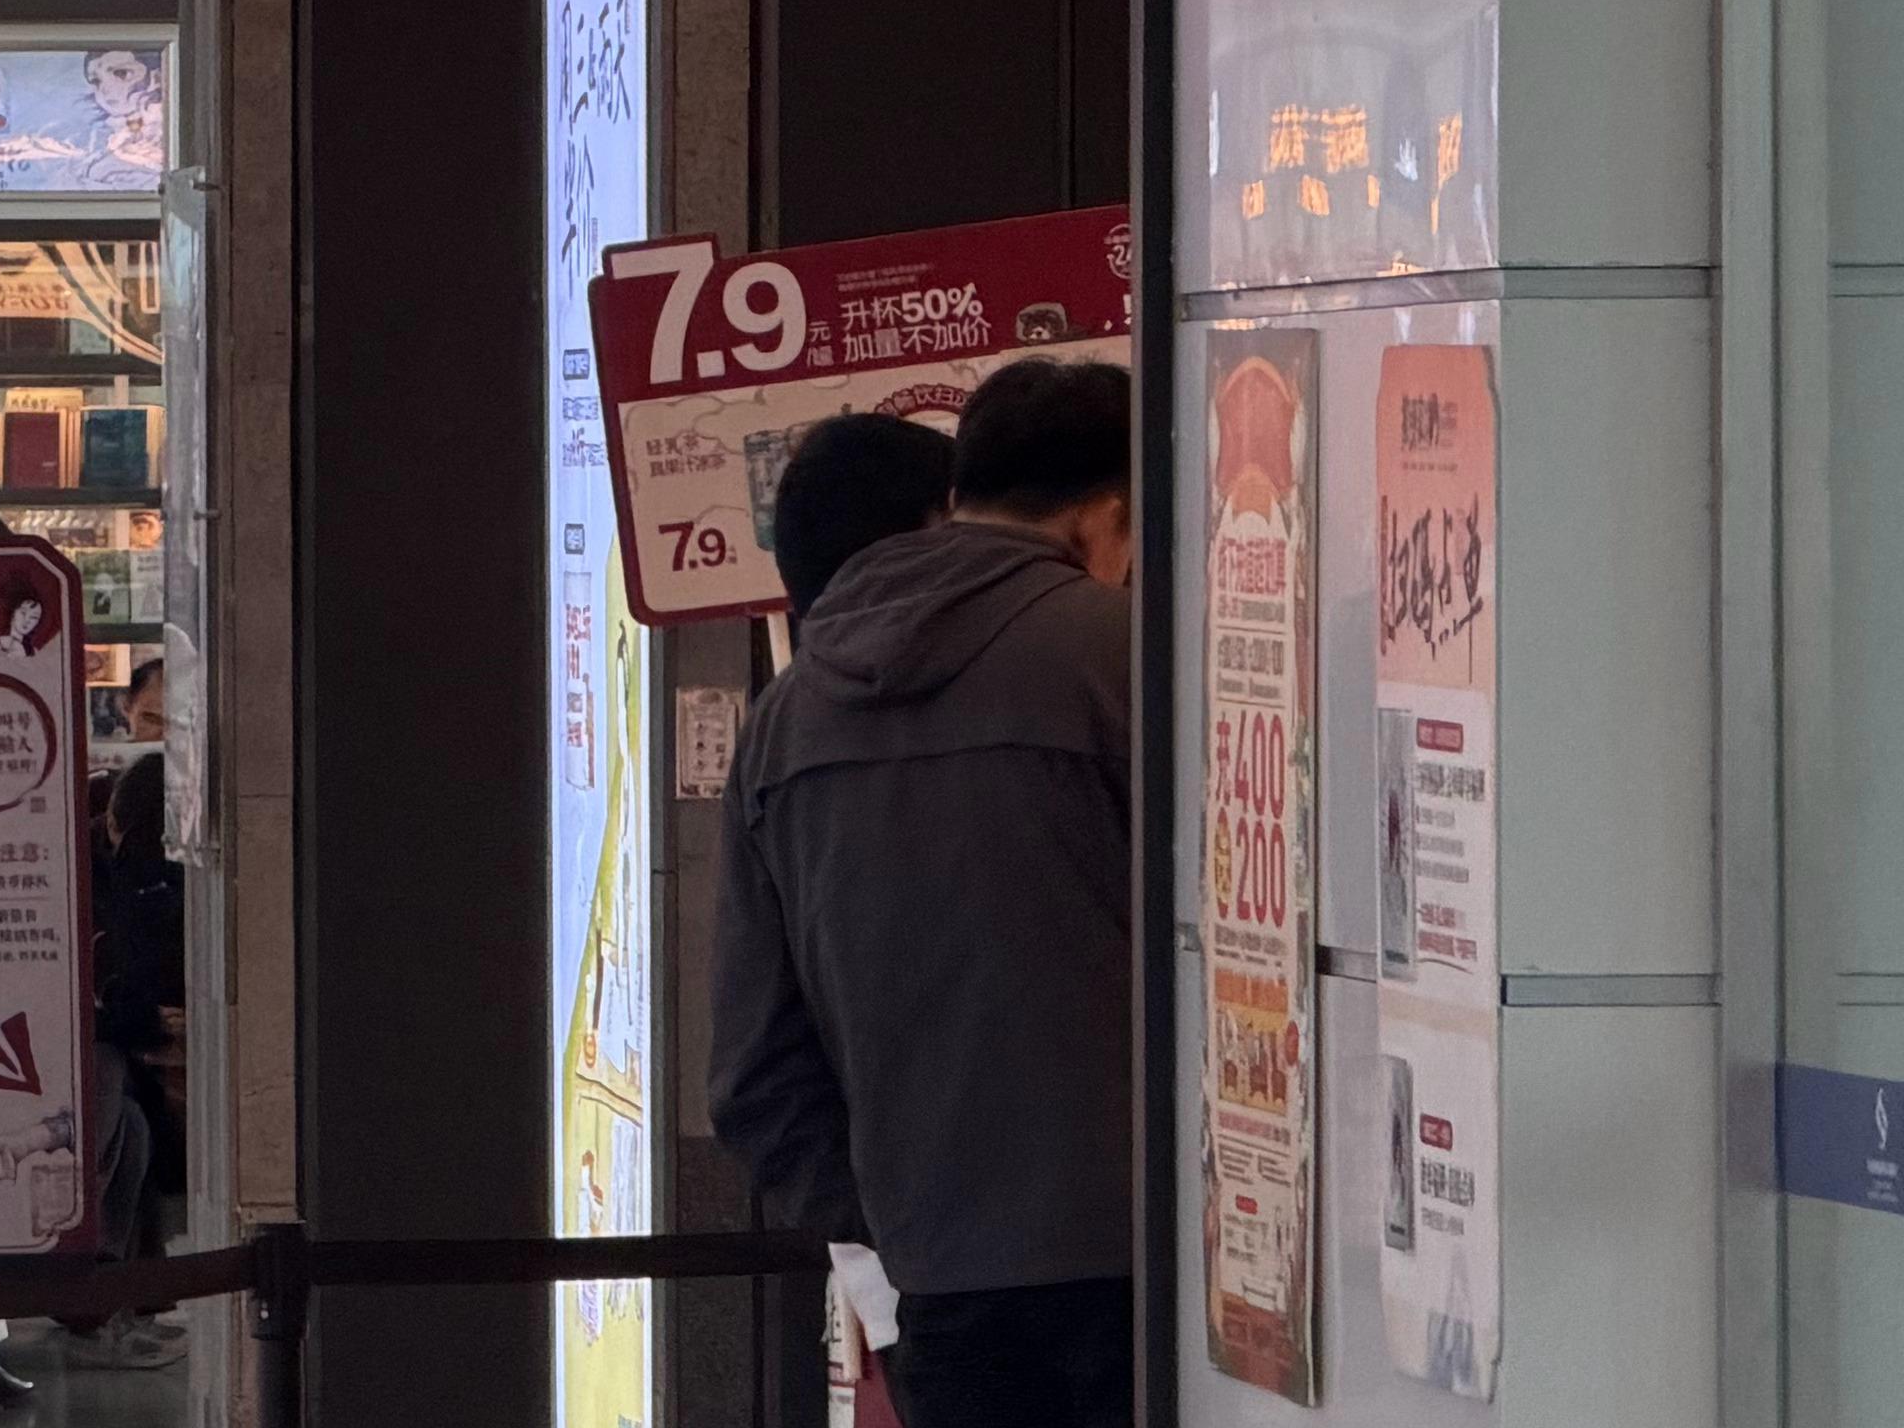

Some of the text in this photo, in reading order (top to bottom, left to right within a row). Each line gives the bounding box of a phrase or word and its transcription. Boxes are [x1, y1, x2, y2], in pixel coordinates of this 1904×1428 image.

[612, 240, 808, 386] 7.9
[843, 316, 992, 365] 加量不加价
[658, 521, 727, 572] 7.9
[1235, 817, 1287, 929] 200
